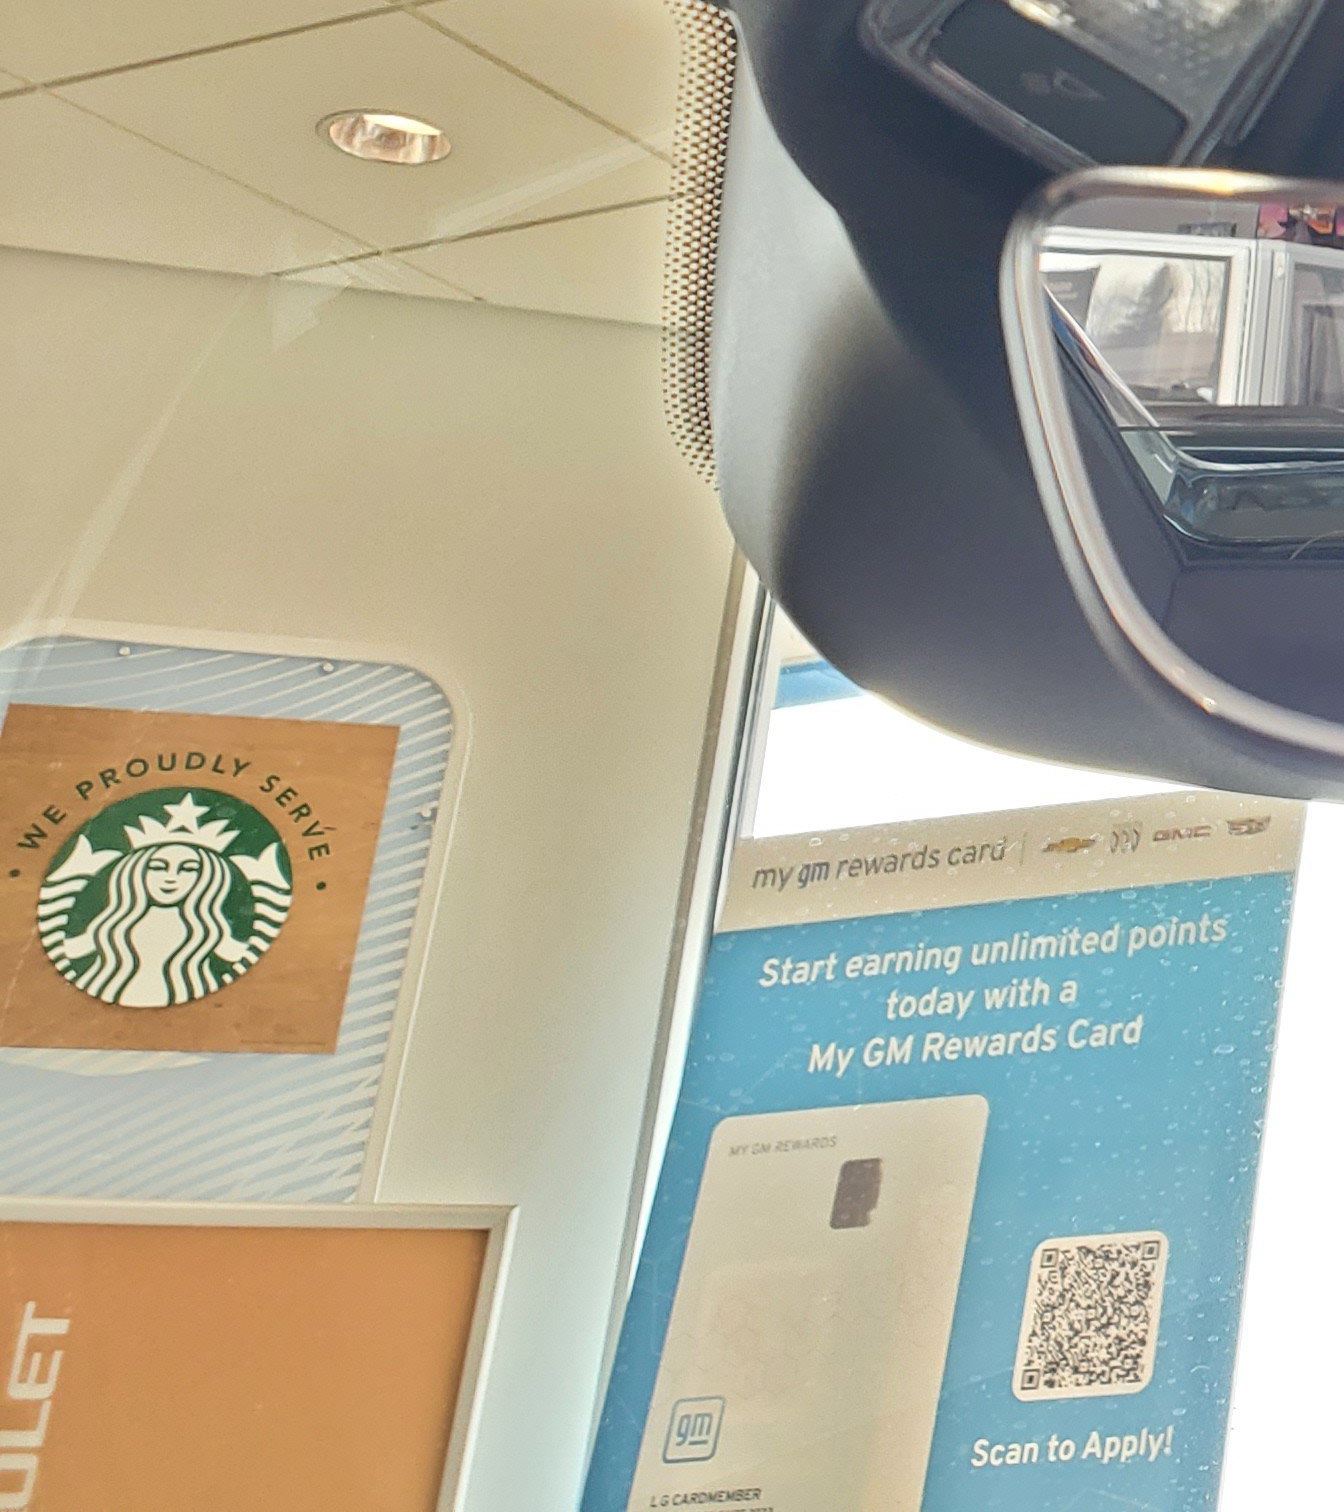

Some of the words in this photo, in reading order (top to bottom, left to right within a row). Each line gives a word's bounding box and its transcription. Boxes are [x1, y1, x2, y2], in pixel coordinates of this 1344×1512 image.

[17, 804, 68, 853] WE
[75, 752, 252, 801] PROUDLY
[259, 774, 331, 862] SERVE
[1152, 825, 1214, 843] GMC
[752, 864, 795, 891] my
[797, 862, 830, 888] gm
[835, 844, 941, 880] rewards
[947, 837, 1008, 867] card
[759, 952, 836, 988] Start
[844, 943, 962, 979] earning
[970, 926, 1120, 968] unlimited
[1128, 914, 1229, 957] points
[886, 987, 975, 1023] today
[982, 979, 1051, 1011] with
[1058, 978, 1078, 1005] a
[807, 1041, 855, 1078] My
[862, 1036, 915, 1070] GM
[921, 1023, 1058, 1063] Rewards
[1067, 1014, 1145, 1050] Card
[728, 1145, 749, 1157] MY
[750, 1142, 772, 1155] GM
[774, 1135, 838, 1153] REWARDS
[675, 1412, 713, 1446] gm
[970, 1438, 1039, 1467] Scan
[1047, 1433, 1076, 1463] to
[1080, 1424, 1175, 1465] Apply!
